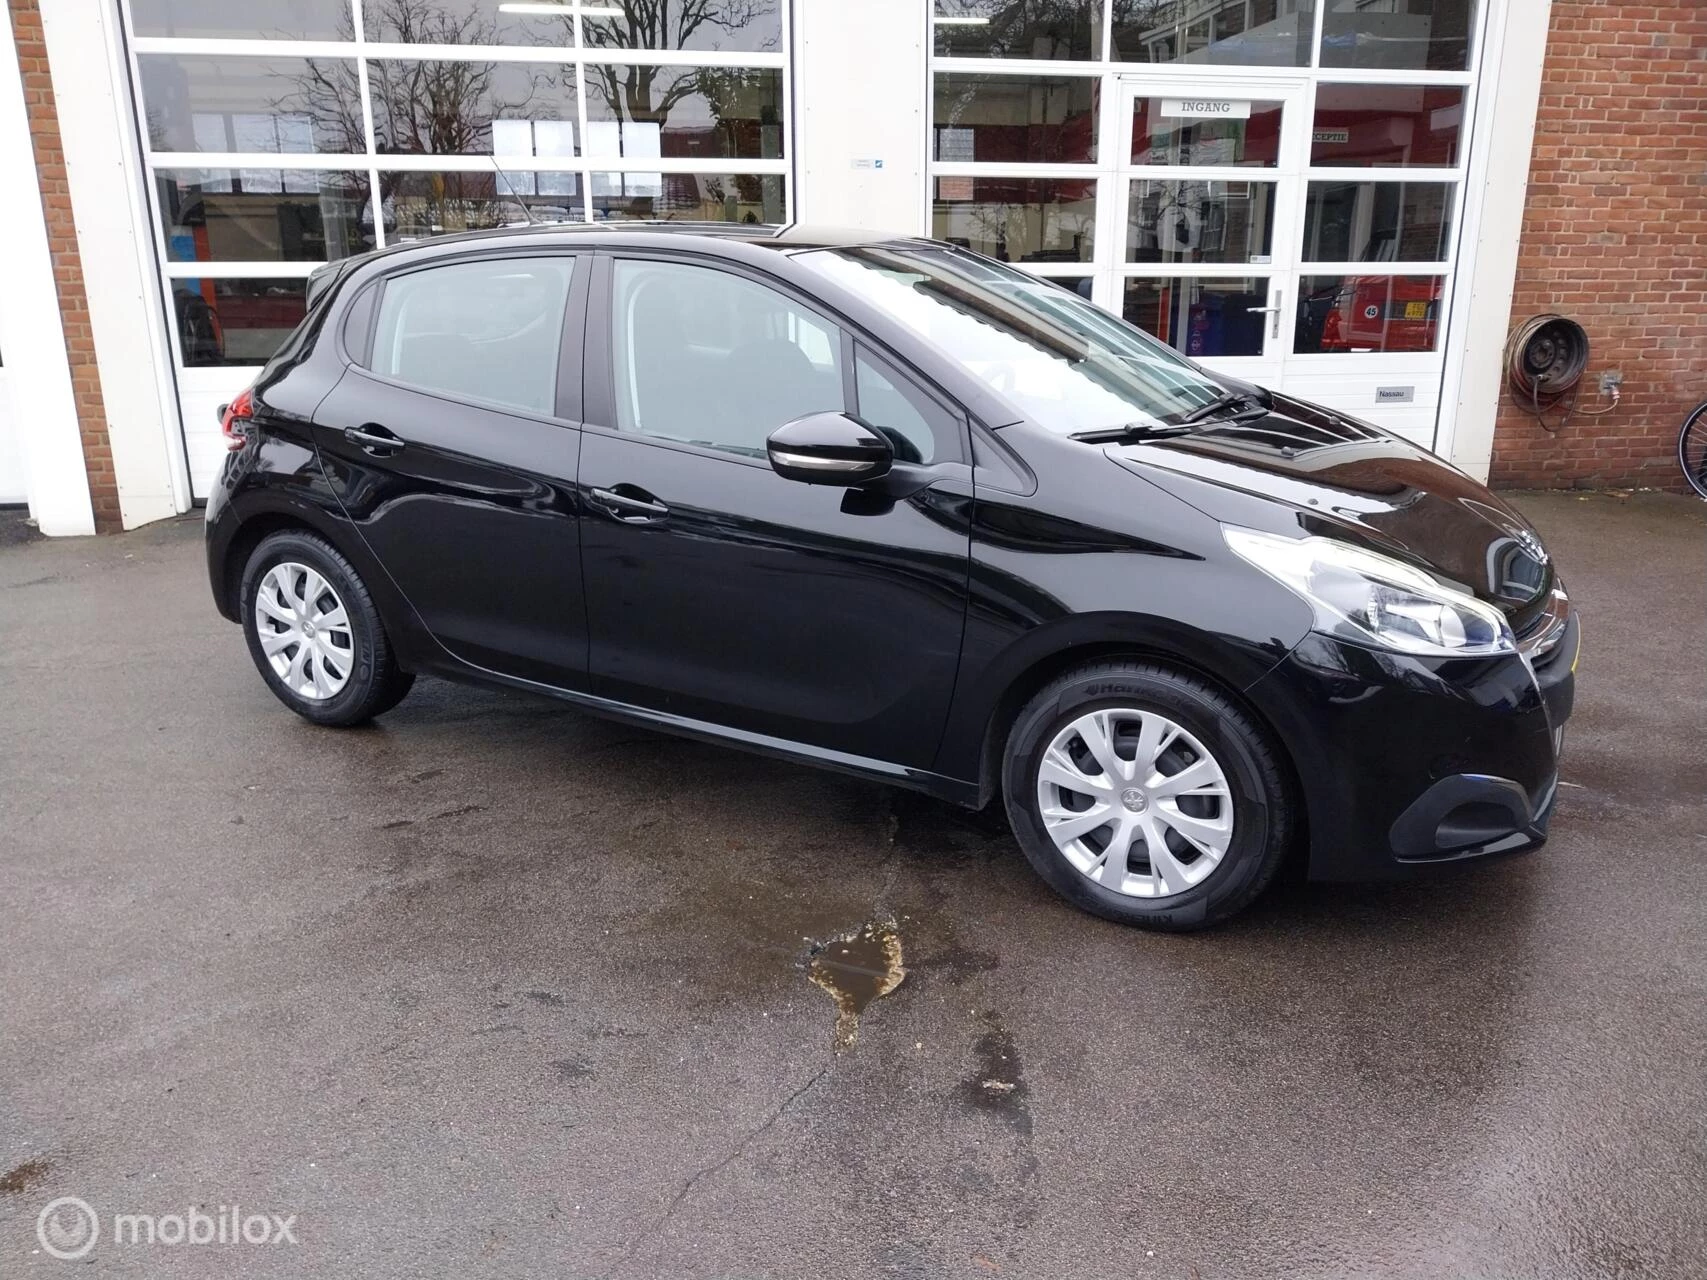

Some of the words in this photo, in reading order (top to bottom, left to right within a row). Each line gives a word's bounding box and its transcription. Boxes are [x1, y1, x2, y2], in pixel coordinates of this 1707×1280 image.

[1181, 102, 1231, 112] INGANG
[1313, 133, 1347, 141] CEPTIE
[1366, 307, 1377, 316] 45
